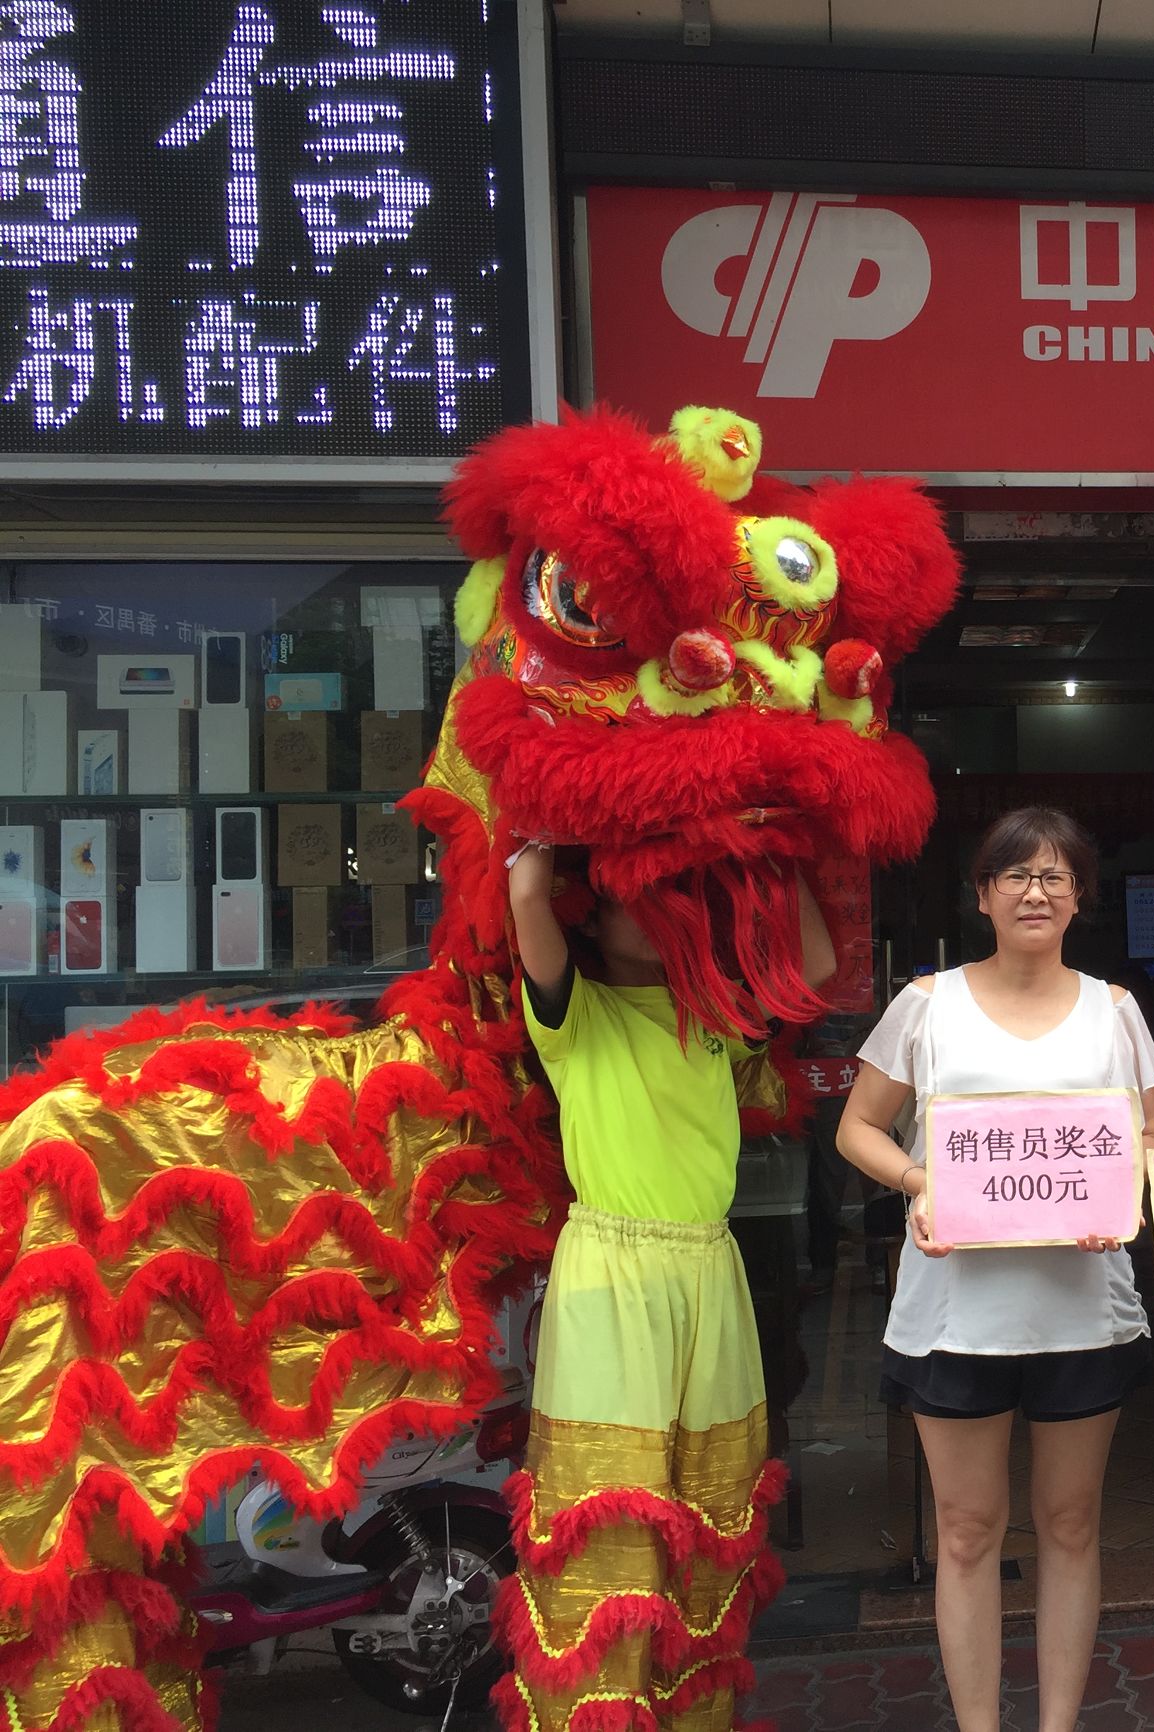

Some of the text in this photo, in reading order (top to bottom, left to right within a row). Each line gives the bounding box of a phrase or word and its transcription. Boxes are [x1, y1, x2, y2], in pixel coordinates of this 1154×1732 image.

[4, 288, 496, 433] 机配件
[278, 632, 289, 665] Galaxy
[946, 1123, 1123, 1164] 销售员奖金
[981, 1169, 1089, 1203] 4000元
